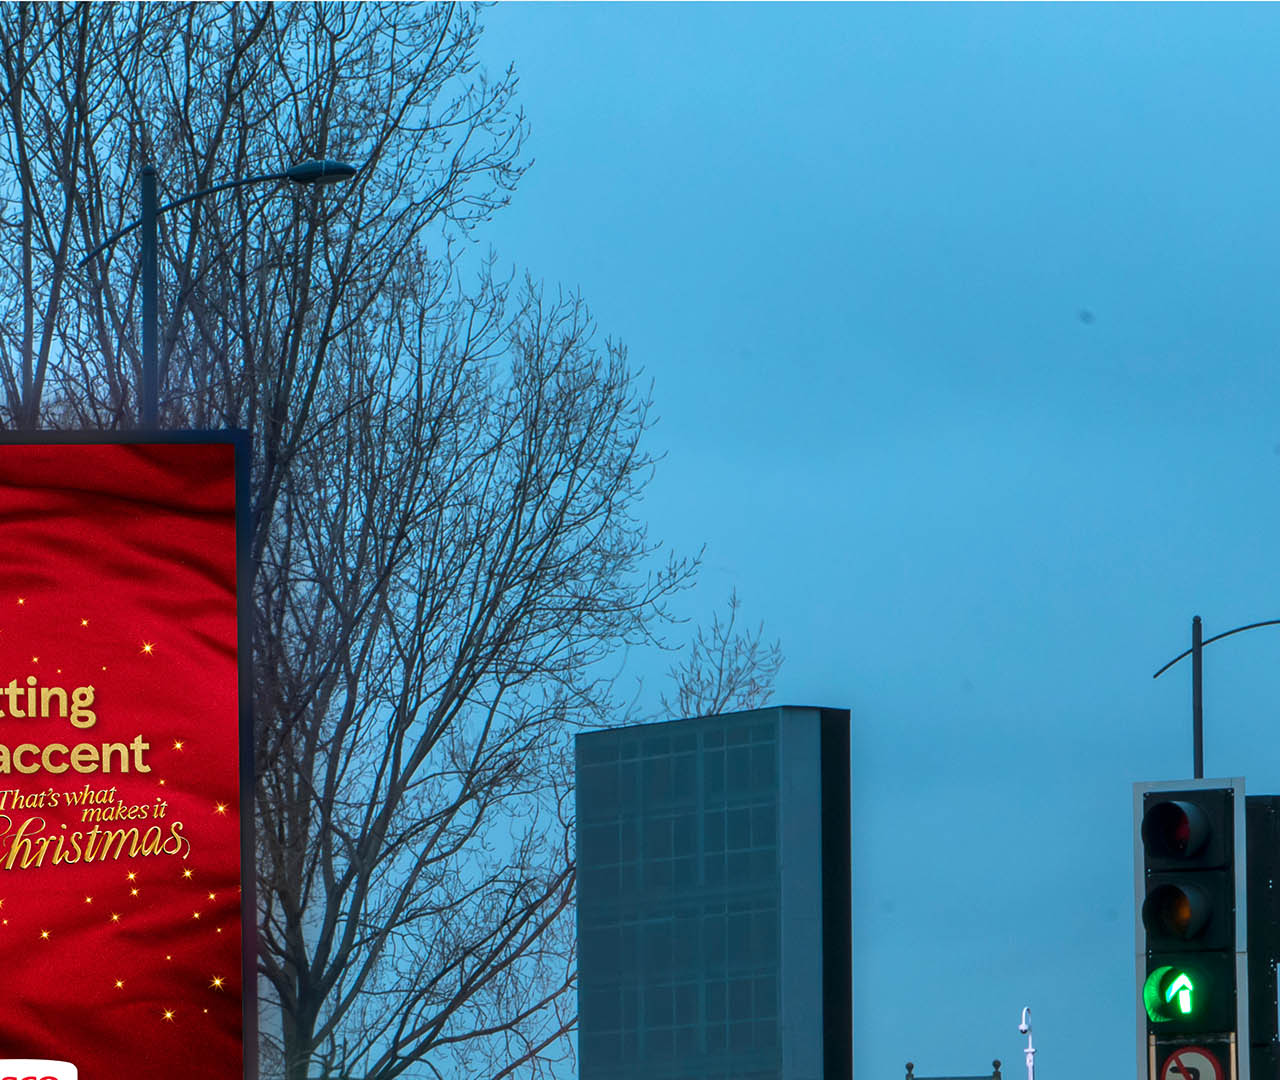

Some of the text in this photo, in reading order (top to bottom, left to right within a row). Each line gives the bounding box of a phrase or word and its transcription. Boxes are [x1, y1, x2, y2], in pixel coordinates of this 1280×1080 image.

[64, 784, 118, 808] what
[81, 797, 169, 823] makes it
